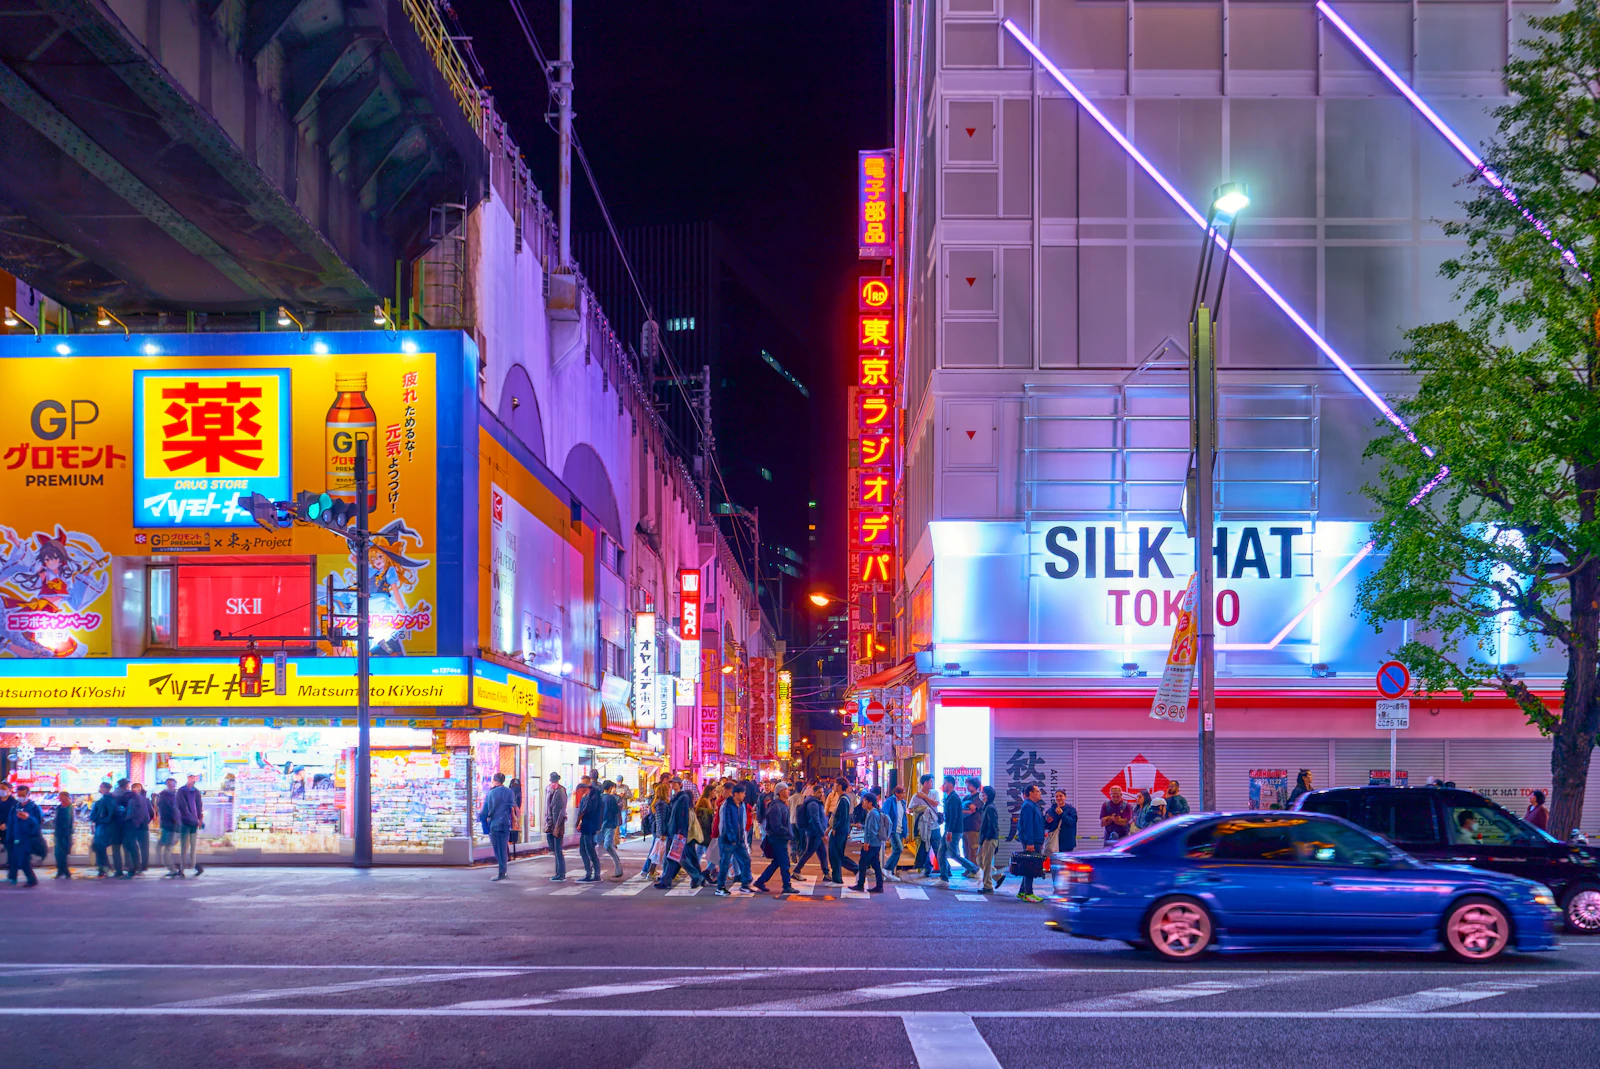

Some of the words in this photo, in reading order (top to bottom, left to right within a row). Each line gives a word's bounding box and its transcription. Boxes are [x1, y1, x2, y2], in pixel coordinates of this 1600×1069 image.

[864, 157, 886, 244] 電子部品
[30, 399, 100, 441] GP
[161, 381, 265, 474] 薬
[3, 442, 126, 470] グロモント
[25, 474, 104, 487] PREMIUM
[174, 480, 208, 490] DRUG
[210, 479, 249, 489] STORE
[151, 534, 170, 546] GP
[253, 536, 292, 550] Project
[1045, 525, 1175, 580] SILK
[1107, 589, 1240, 627] TOKO
[9, 614, 100, 629] コラボキャンペーン
[335, 614, 430, 630] アクルスタンド
[684, 602, 697, 636] KFC
[0, 688, 68, 699] atsumoto
[71, 686, 126, 698] KiYoshi
[297, 685, 385, 697] Matsumto
[388, 685, 444, 697] KiYoshi
[1479, 788, 1499, 797] SILK
[1500, 788, 1518, 797] HAT
